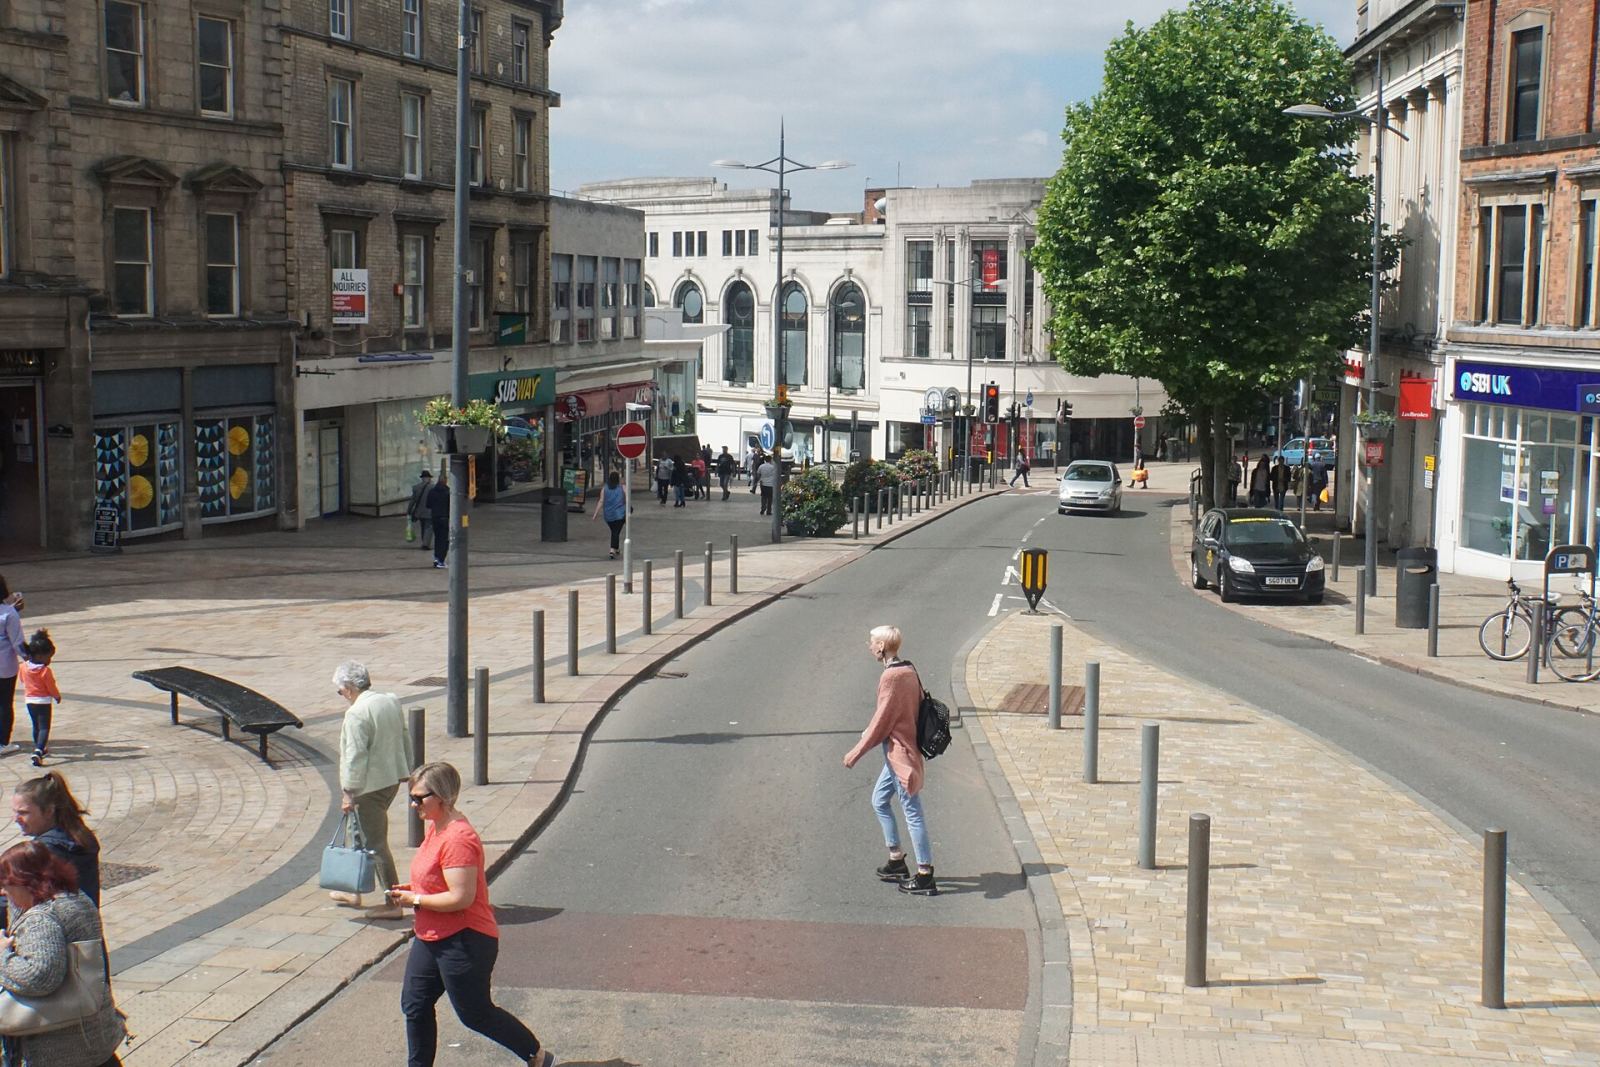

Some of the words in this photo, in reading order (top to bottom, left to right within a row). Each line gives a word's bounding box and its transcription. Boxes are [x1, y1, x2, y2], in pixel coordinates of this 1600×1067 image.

[341, 272, 354, 281] ALL
[333, 282, 366, 291] NQUIRIES
[495, 376, 541, 403] SUBWAY
[1472, 373, 1491, 393] SBI
[1492, 374, 1512, 396] UK
[635, 387, 651, 405] KFC
[1559, 556, 1567, 568] P
